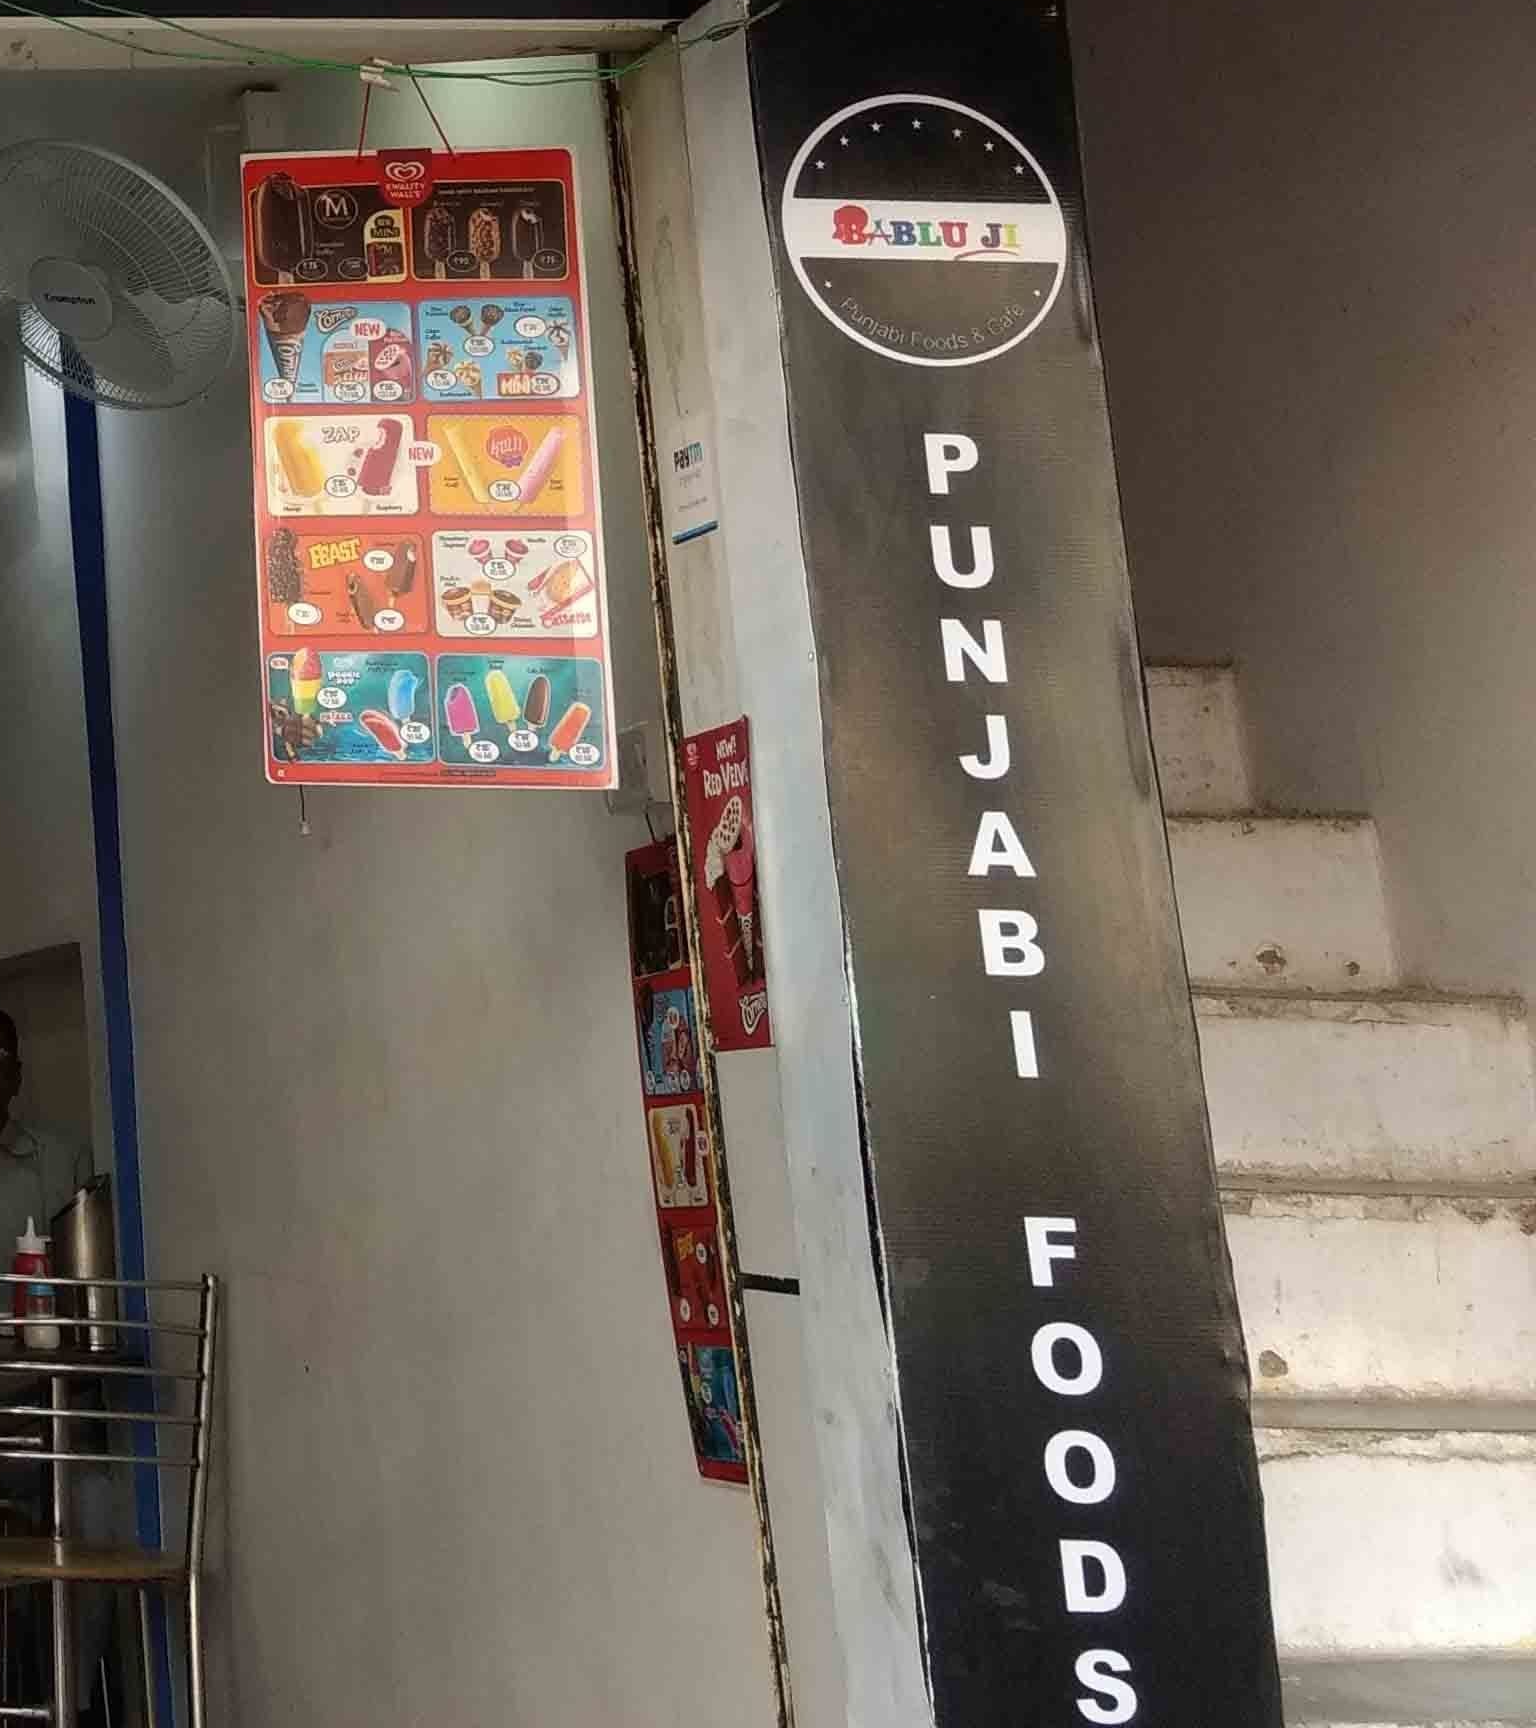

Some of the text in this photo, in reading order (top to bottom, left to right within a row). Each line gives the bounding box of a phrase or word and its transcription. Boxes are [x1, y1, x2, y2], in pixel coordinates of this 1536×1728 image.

[840, 219, 1022, 249] BABLU JI
[354, 323, 381, 337] NEW
[408, 447, 434, 461] NEW
[922, 430, 1046, 1082] PUNJABI
[1023, 1214, 1138, 1726] FOODS
